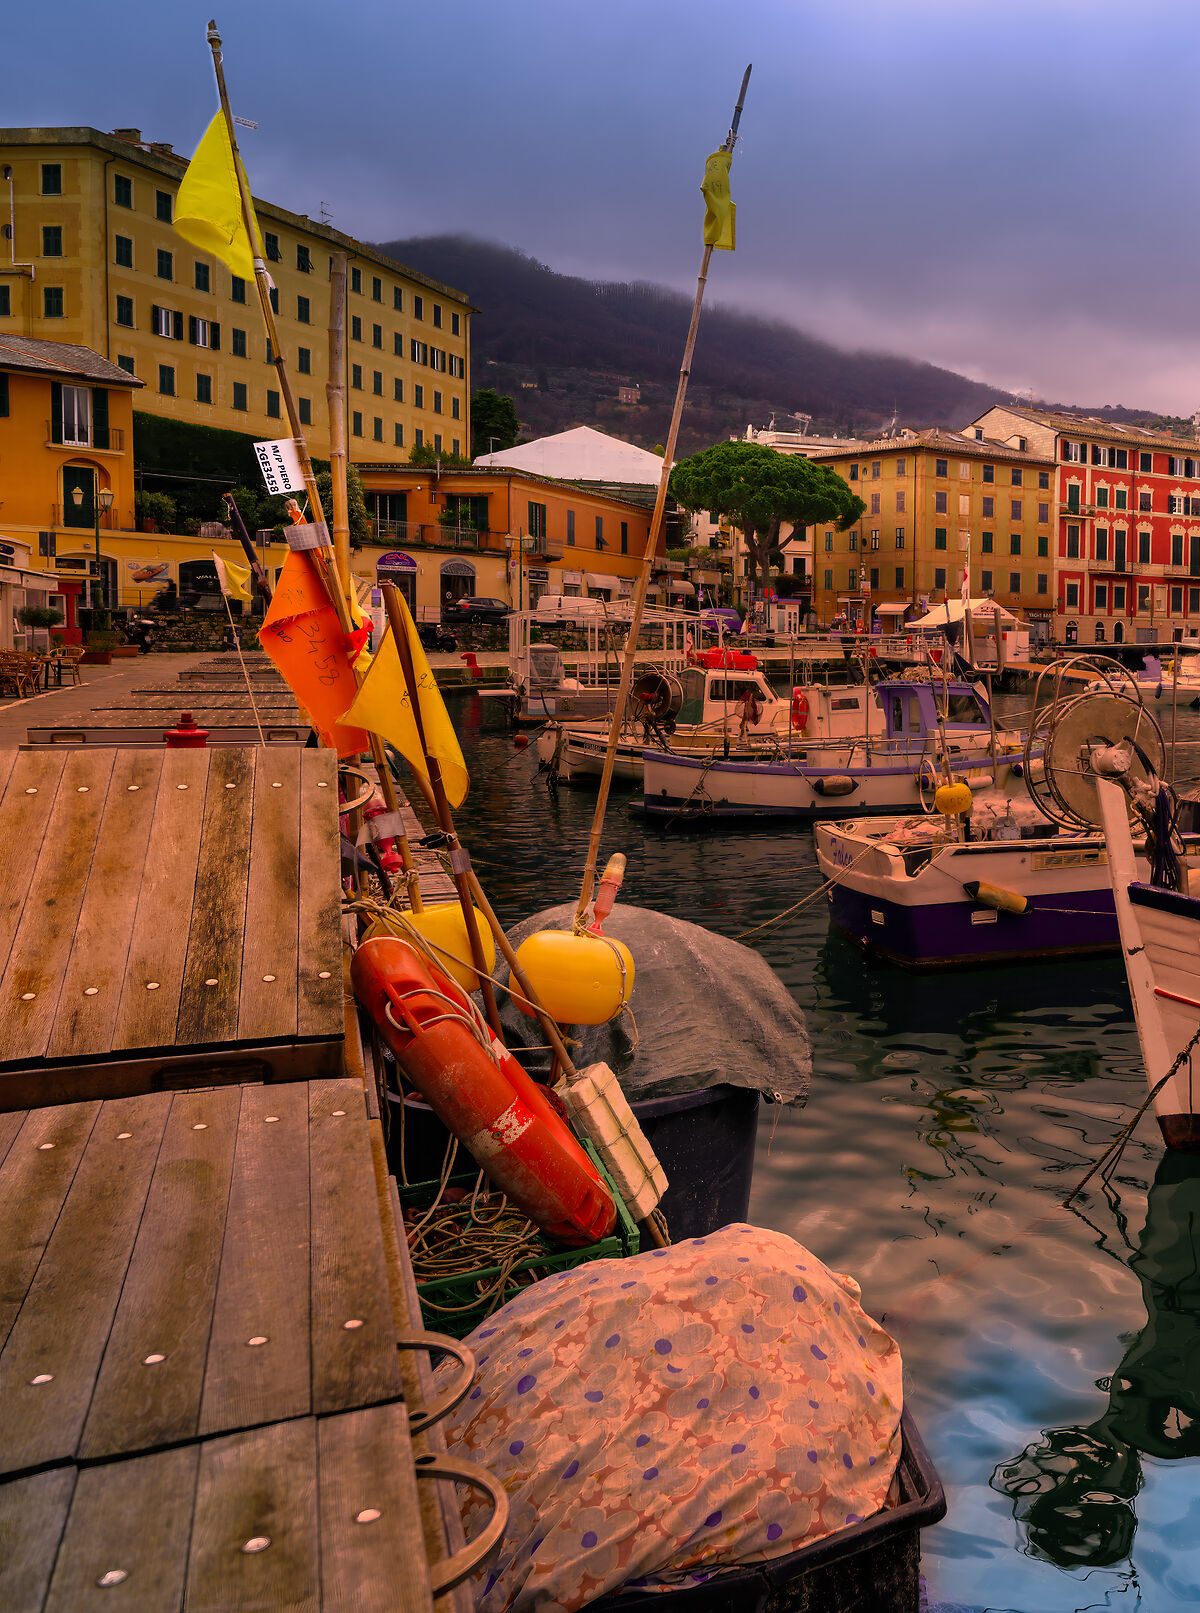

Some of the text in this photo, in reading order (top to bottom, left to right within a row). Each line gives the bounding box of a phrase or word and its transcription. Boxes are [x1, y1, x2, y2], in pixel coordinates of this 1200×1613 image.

[256, 446, 279, 493] 2GE3458
[271, 445, 292, 490] M/P PIERO
